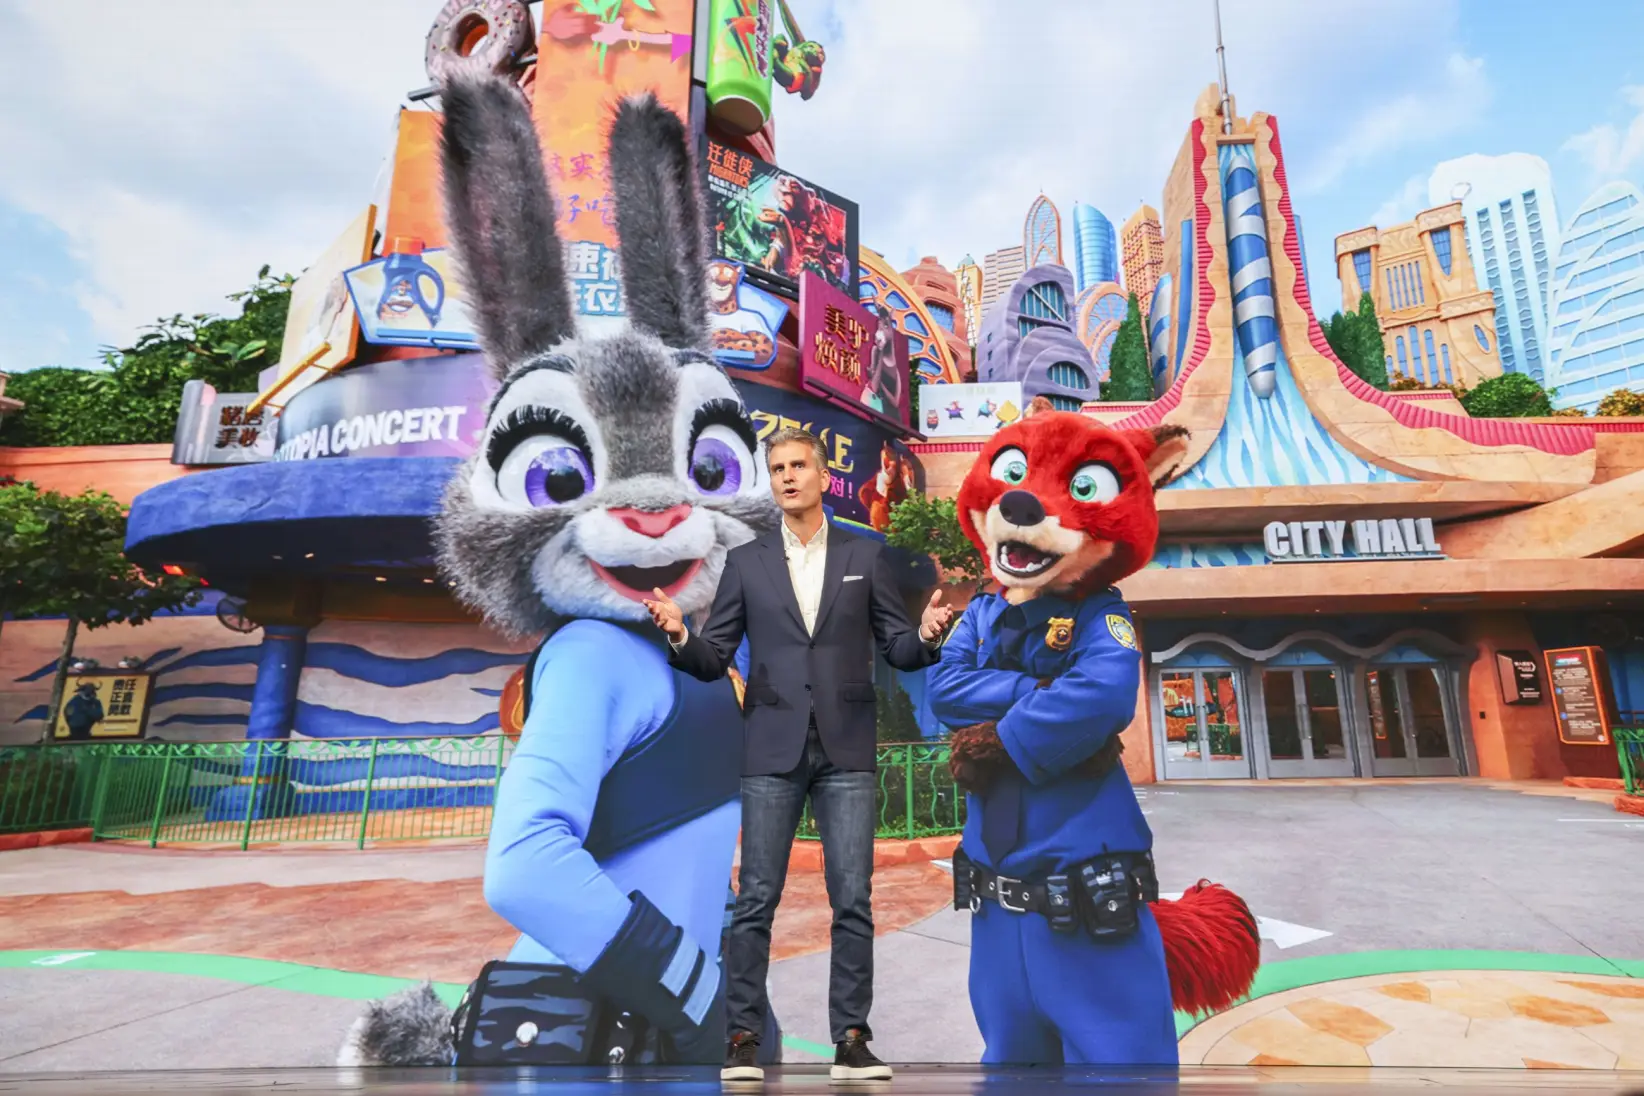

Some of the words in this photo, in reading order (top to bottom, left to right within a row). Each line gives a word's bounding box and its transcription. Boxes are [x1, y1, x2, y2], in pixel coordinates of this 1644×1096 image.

[706, 140, 754, 178] 迁徙侠
[331, 406, 467, 454] CONCERT
[1263, 520, 1347, 557] CITY
[1351, 517, 1442, 554] HALL
